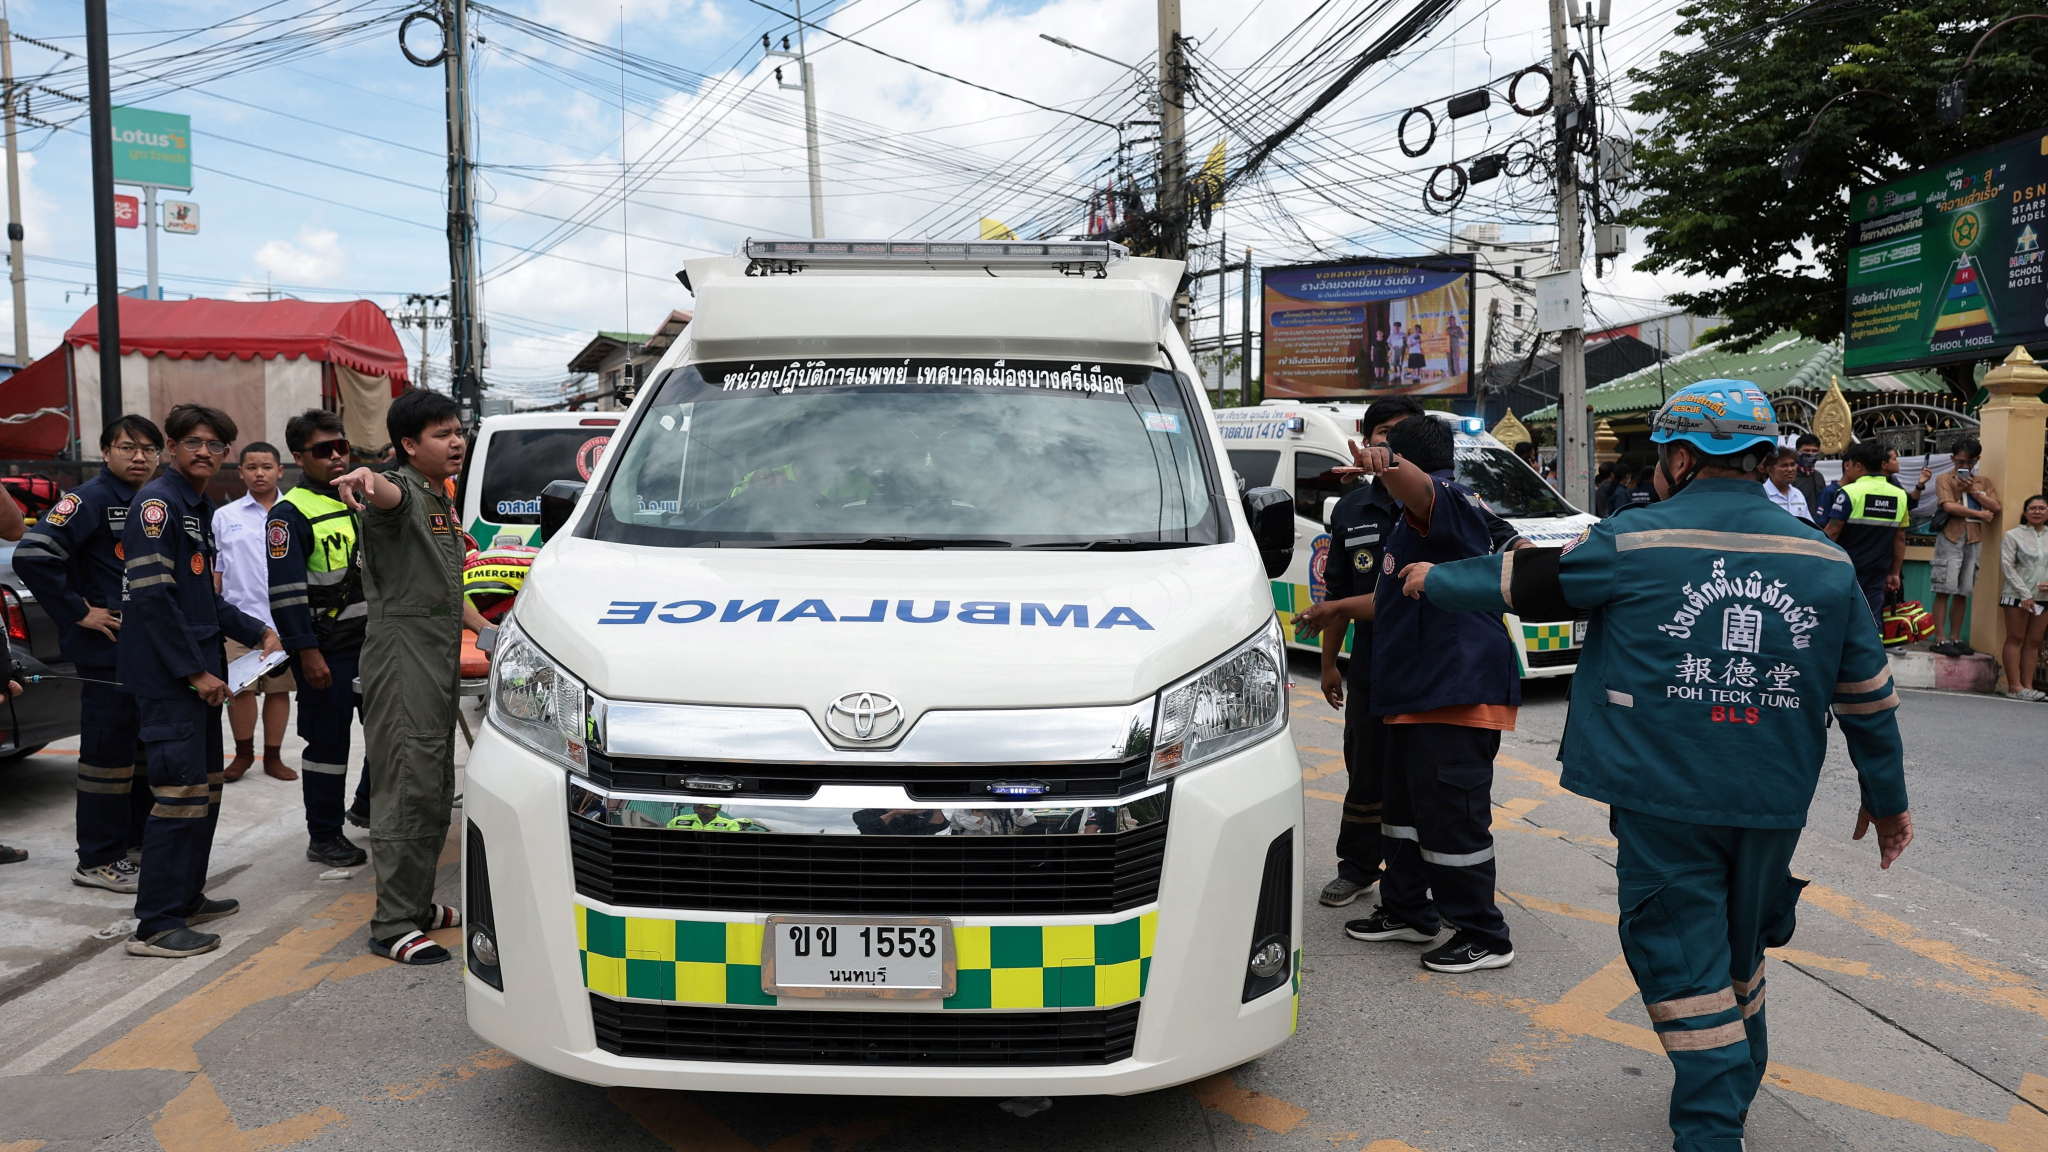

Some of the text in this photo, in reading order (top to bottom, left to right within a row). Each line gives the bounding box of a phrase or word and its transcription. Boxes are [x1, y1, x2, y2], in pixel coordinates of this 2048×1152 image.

[111, 126, 186, 149] Lotus's
[129, 149, 187, 164] go fresh
[2012, 199, 2046, 215] STARS
[2011, 210, 2046, 225] MODEL
[1859, 243, 1921, 268] 2567-2569
[2009, 250, 2045, 268] HAPPY
[2009, 265, 2043, 278] SCHOOL
[1301, 275, 1425, 291] รางวัลยอดเยี่ยม อันดับ 1
[2008, 275, 2042, 288] MODEL
[1852, 283, 1923, 305] วิสัยทัศน์ (Vision)
[1930, 335, 1995, 352] SCHOOL MODEL
[723, 359, 1125, 395] หน่วยปฏิบัติการแพทย์ เทศบาลเมืองบางศรีเมือง
[1672, 405, 1702, 413] RESCUE
[1752, 407, 1771, 421] 65
[1256, 422, 1287, 439] 1418
[467, 569, 525, 579] EMERGEN
[1667, 685, 1800, 709] POH TECK TUNG
[1711, 706, 1760, 725] BLS
[859, 927, 936, 957] 1553
[829, 967, 887, 985] นนทบุรี
